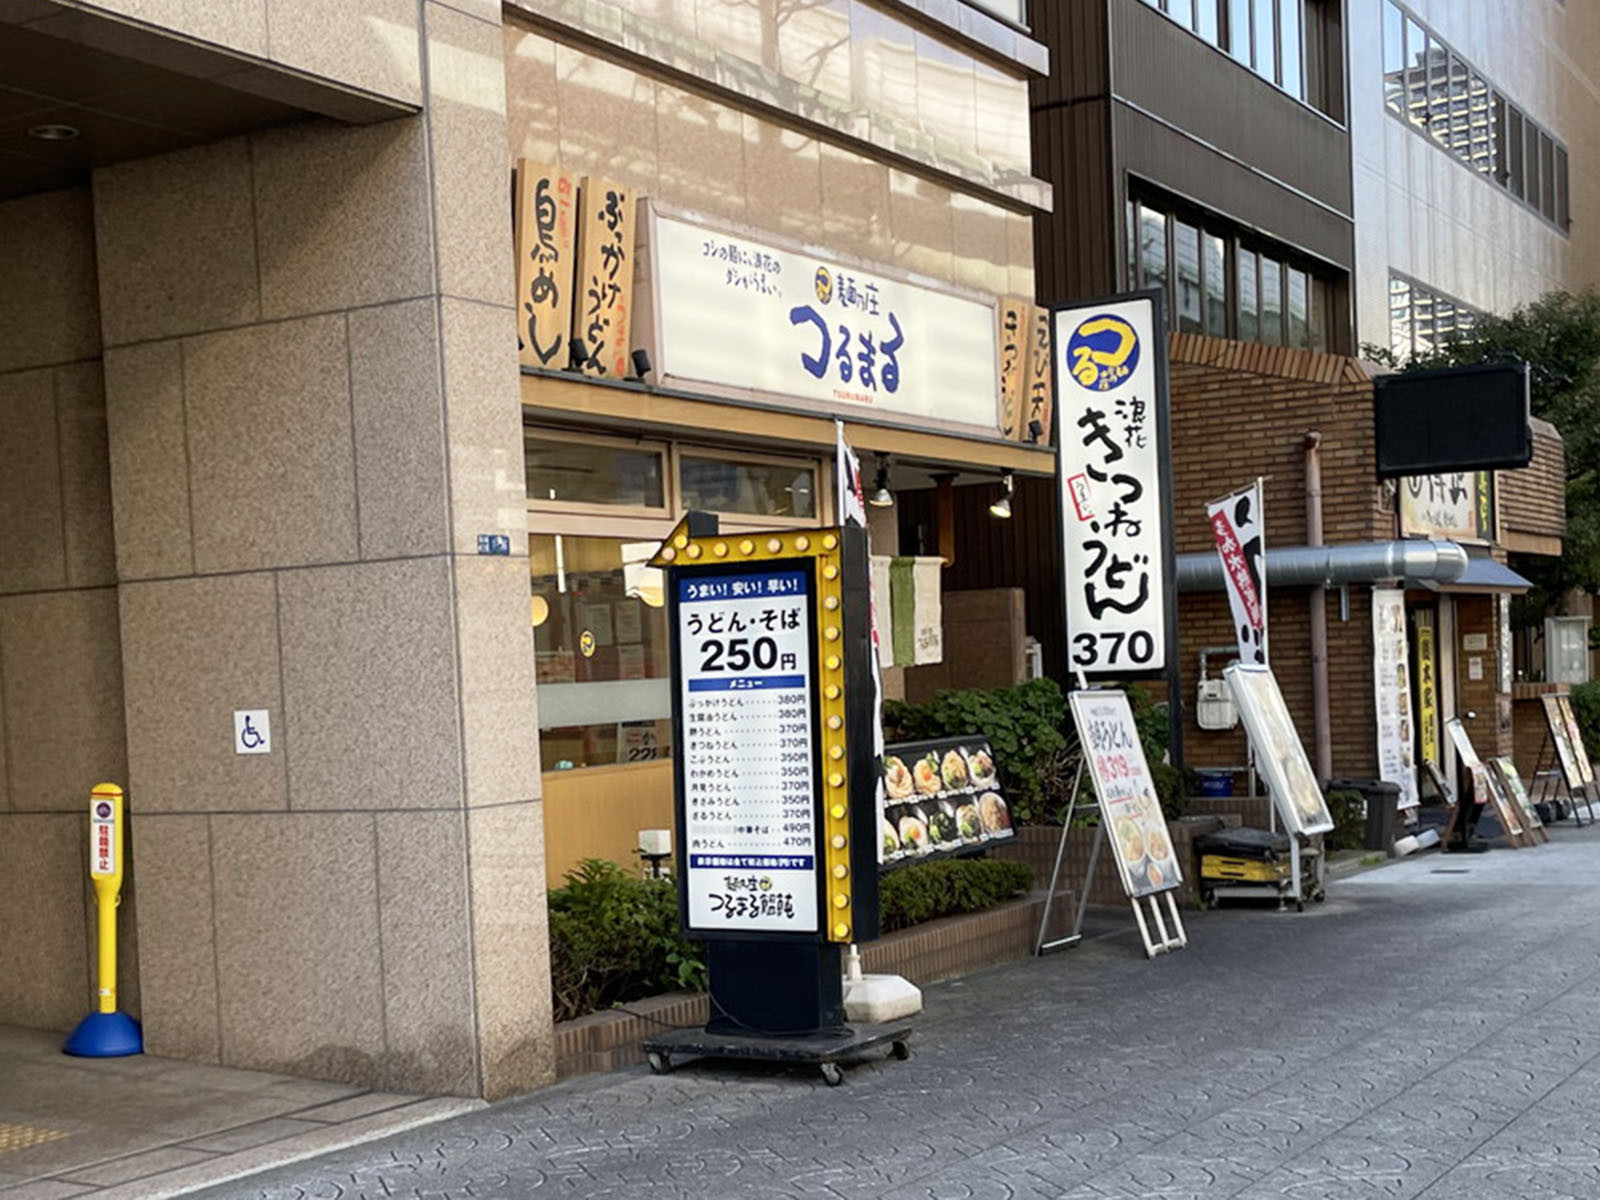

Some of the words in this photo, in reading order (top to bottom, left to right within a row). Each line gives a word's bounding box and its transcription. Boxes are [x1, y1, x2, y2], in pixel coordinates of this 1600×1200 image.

[789, 305, 904, 393] つるまる
[1114, 395, 1147, 449] 浪花
[1077, 407, 1149, 621] きつねうどん
[688, 608, 800, 635] うどん・そば
[700, 636, 796, 672] 250円
[1072, 630, 1154, 666] 370
[729, 679, 763, 689] メニュー
